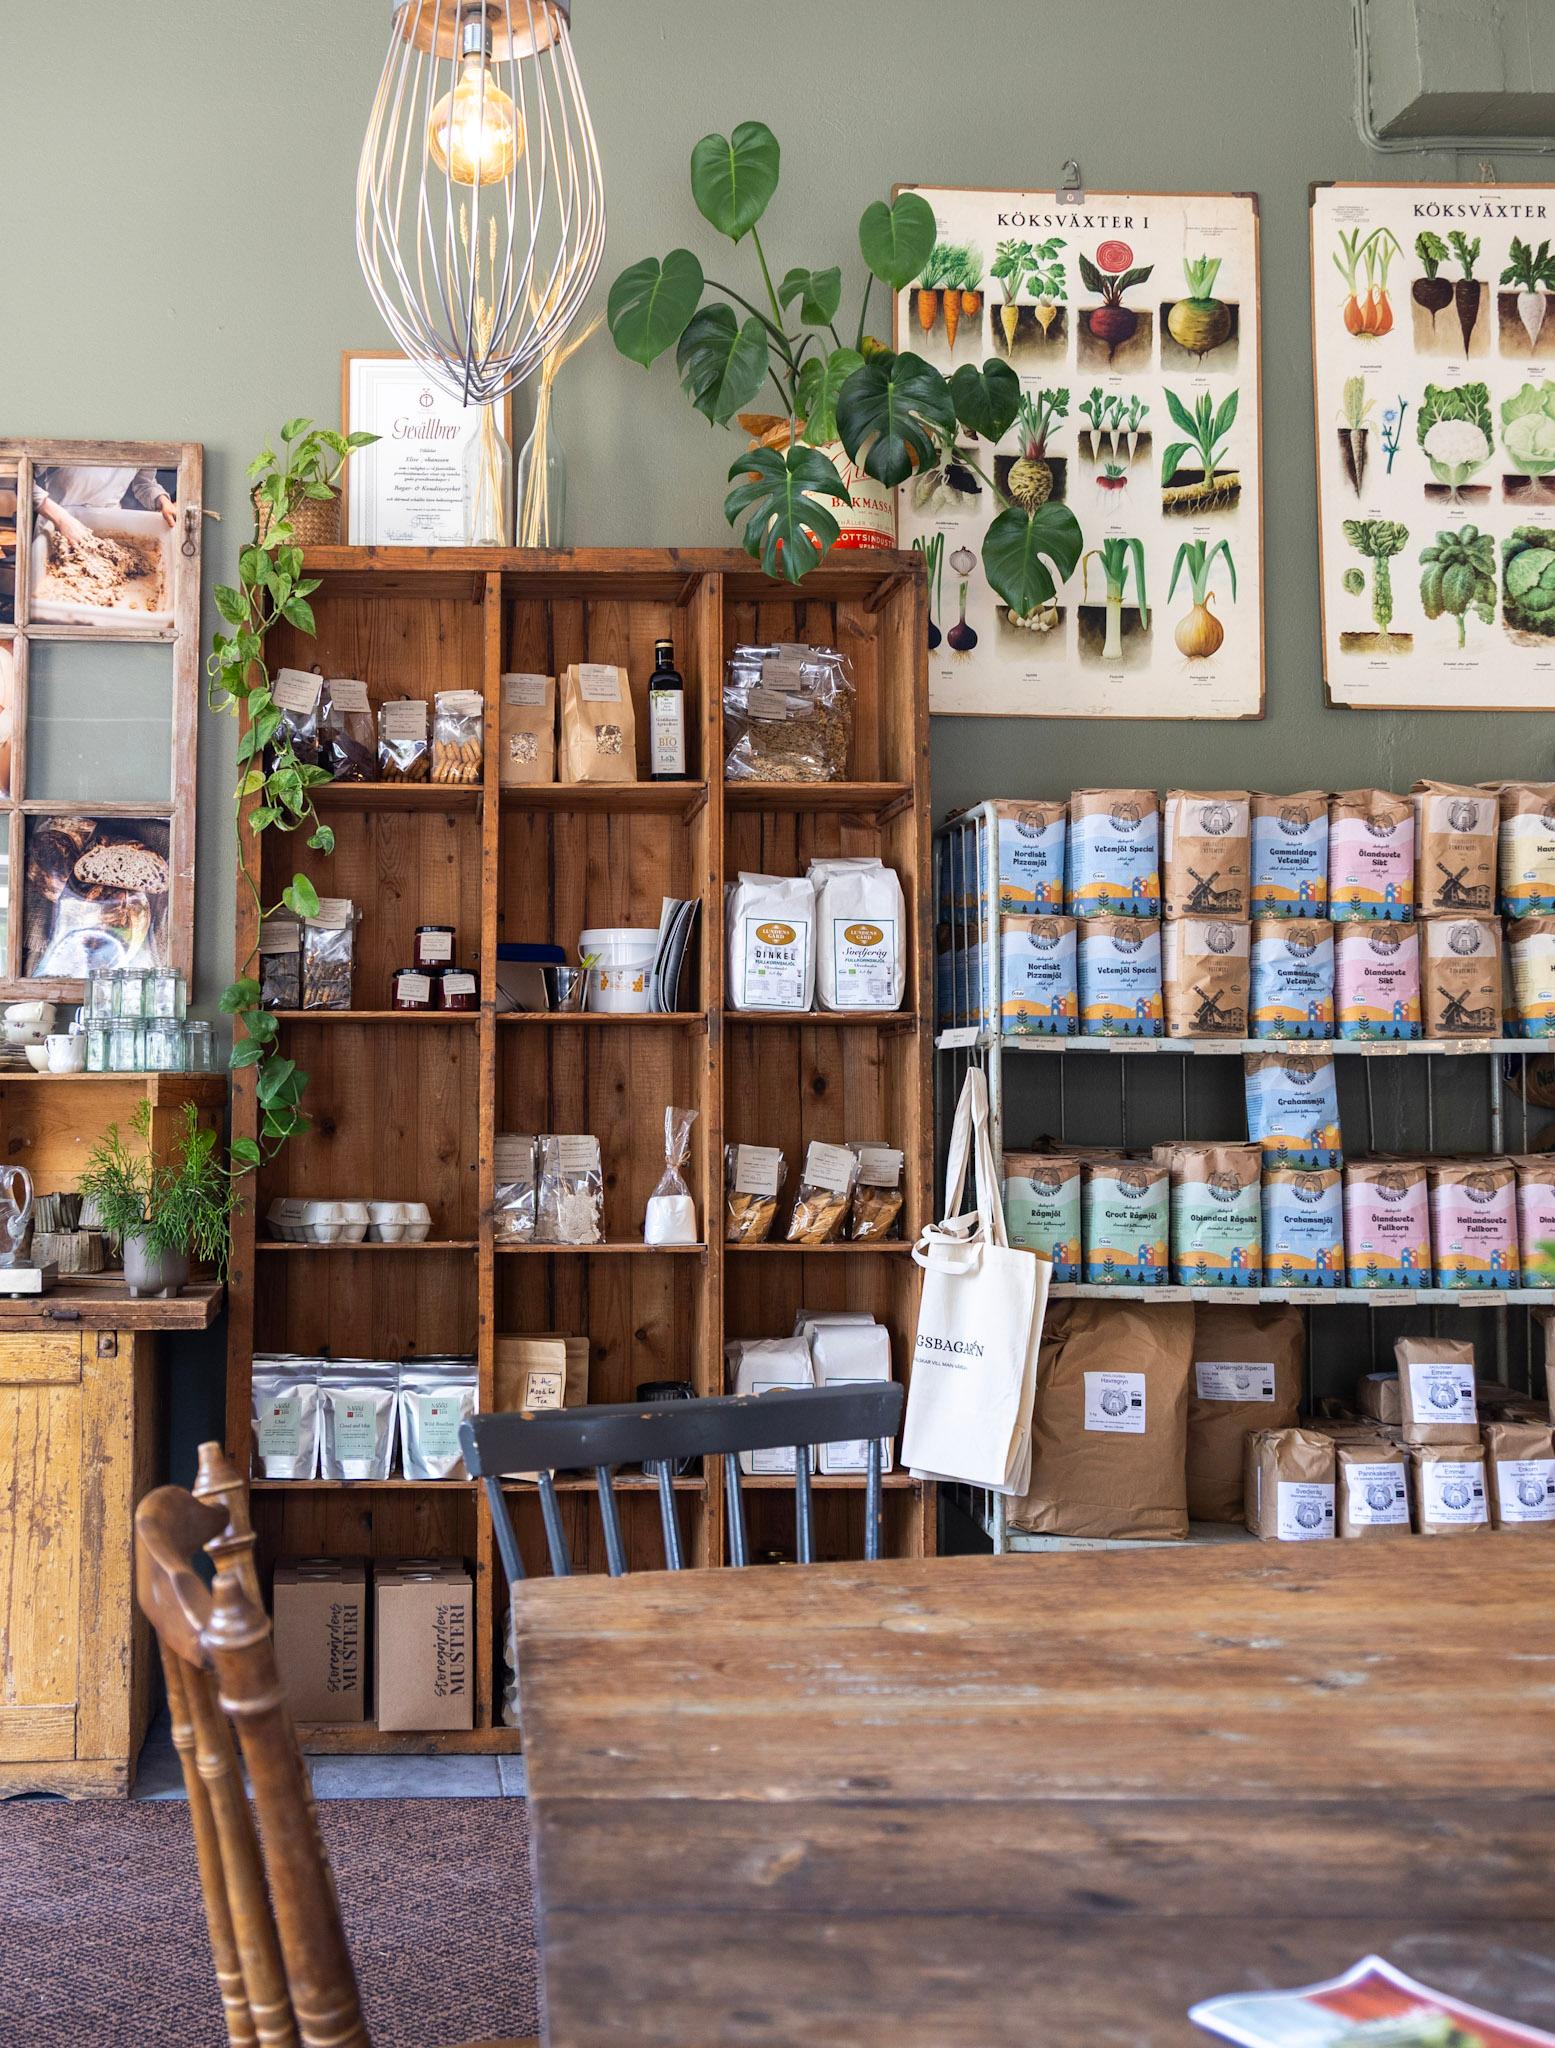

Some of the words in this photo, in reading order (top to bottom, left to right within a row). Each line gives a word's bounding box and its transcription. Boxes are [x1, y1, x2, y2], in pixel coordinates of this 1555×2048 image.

[1413, 202, 1547, 219] KÖKSVÄXTER
[997, 210, 1134, 229] KÖKSVÄXTER
[1144, 216, 1149, 229] I
[391, 416, 461, 440] Gesällbrev
[659, 737, 677, 747] BIO
[1014, 850, 1047, 858] Nordiskt
[1094, 845, 1127, 854] Vetemjöl
[1129, 845, 1154, 854] Special
[1269, 848, 1317, 857] Gammaldags
[1358, 849, 1401, 859] Ölandsvete
[1013, 858, 1047, 868] Pizzamjöl
[1278, 856, 1310, 865] Vetemjöl
[1372, 858, 1388, 866] Sikt
[762, 928, 790, 936] LUNDENS
[767, 932, 785, 940] GÅRD
[756, 950, 796, 961] DINKEL
[842, 947, 888, 959] Svedjeråg
[1028, 963, 1061, 971] Nordiskt
[1098, 967, 1130, 975] Vetemjöl
[1132, 967, 1157, 975] Special
[1027, 972, 1062, 980] Pizzamjöl
[1277, 969, 1320, 978] Gammaldags
[1364, 968, 1406, 977] Ölandsvete
[1286, 977, 1317, 986] Vetemjöl
[1277, 1098, 1326, 1106] Grahamsmjöl
[1031, 1209, 1061, 1218] Rågmjöl
[1105, 1210, 1127, 1218] Grovt
[1129, 1211, 1158, 1220] Rågmjöl
[1371, 1213, 1415, 1223] Ölandsvete
[1190, 1214, 1228, 1222] Oblandad
[1230, 1215, 1258, 1224] Rågsikt
[1284, 1215, 1333, 1224] Grahamsmjöl
[1456, 1216, 1507, 1224] Hallandsvete
[1377, 1223, 1410, 1231] Fullkorn
[1467, 1225, 1498, 1233] Fullkorn
[1215, 1364, 1243, 1372] Vetemjöl
[540, 1377, 552, 1386] the
[535, 1396, 548, 1404] Tea
[342, 1604, 358, 1691] MUSTERI
[450, 1605, 465, 1695] MUSTERI
